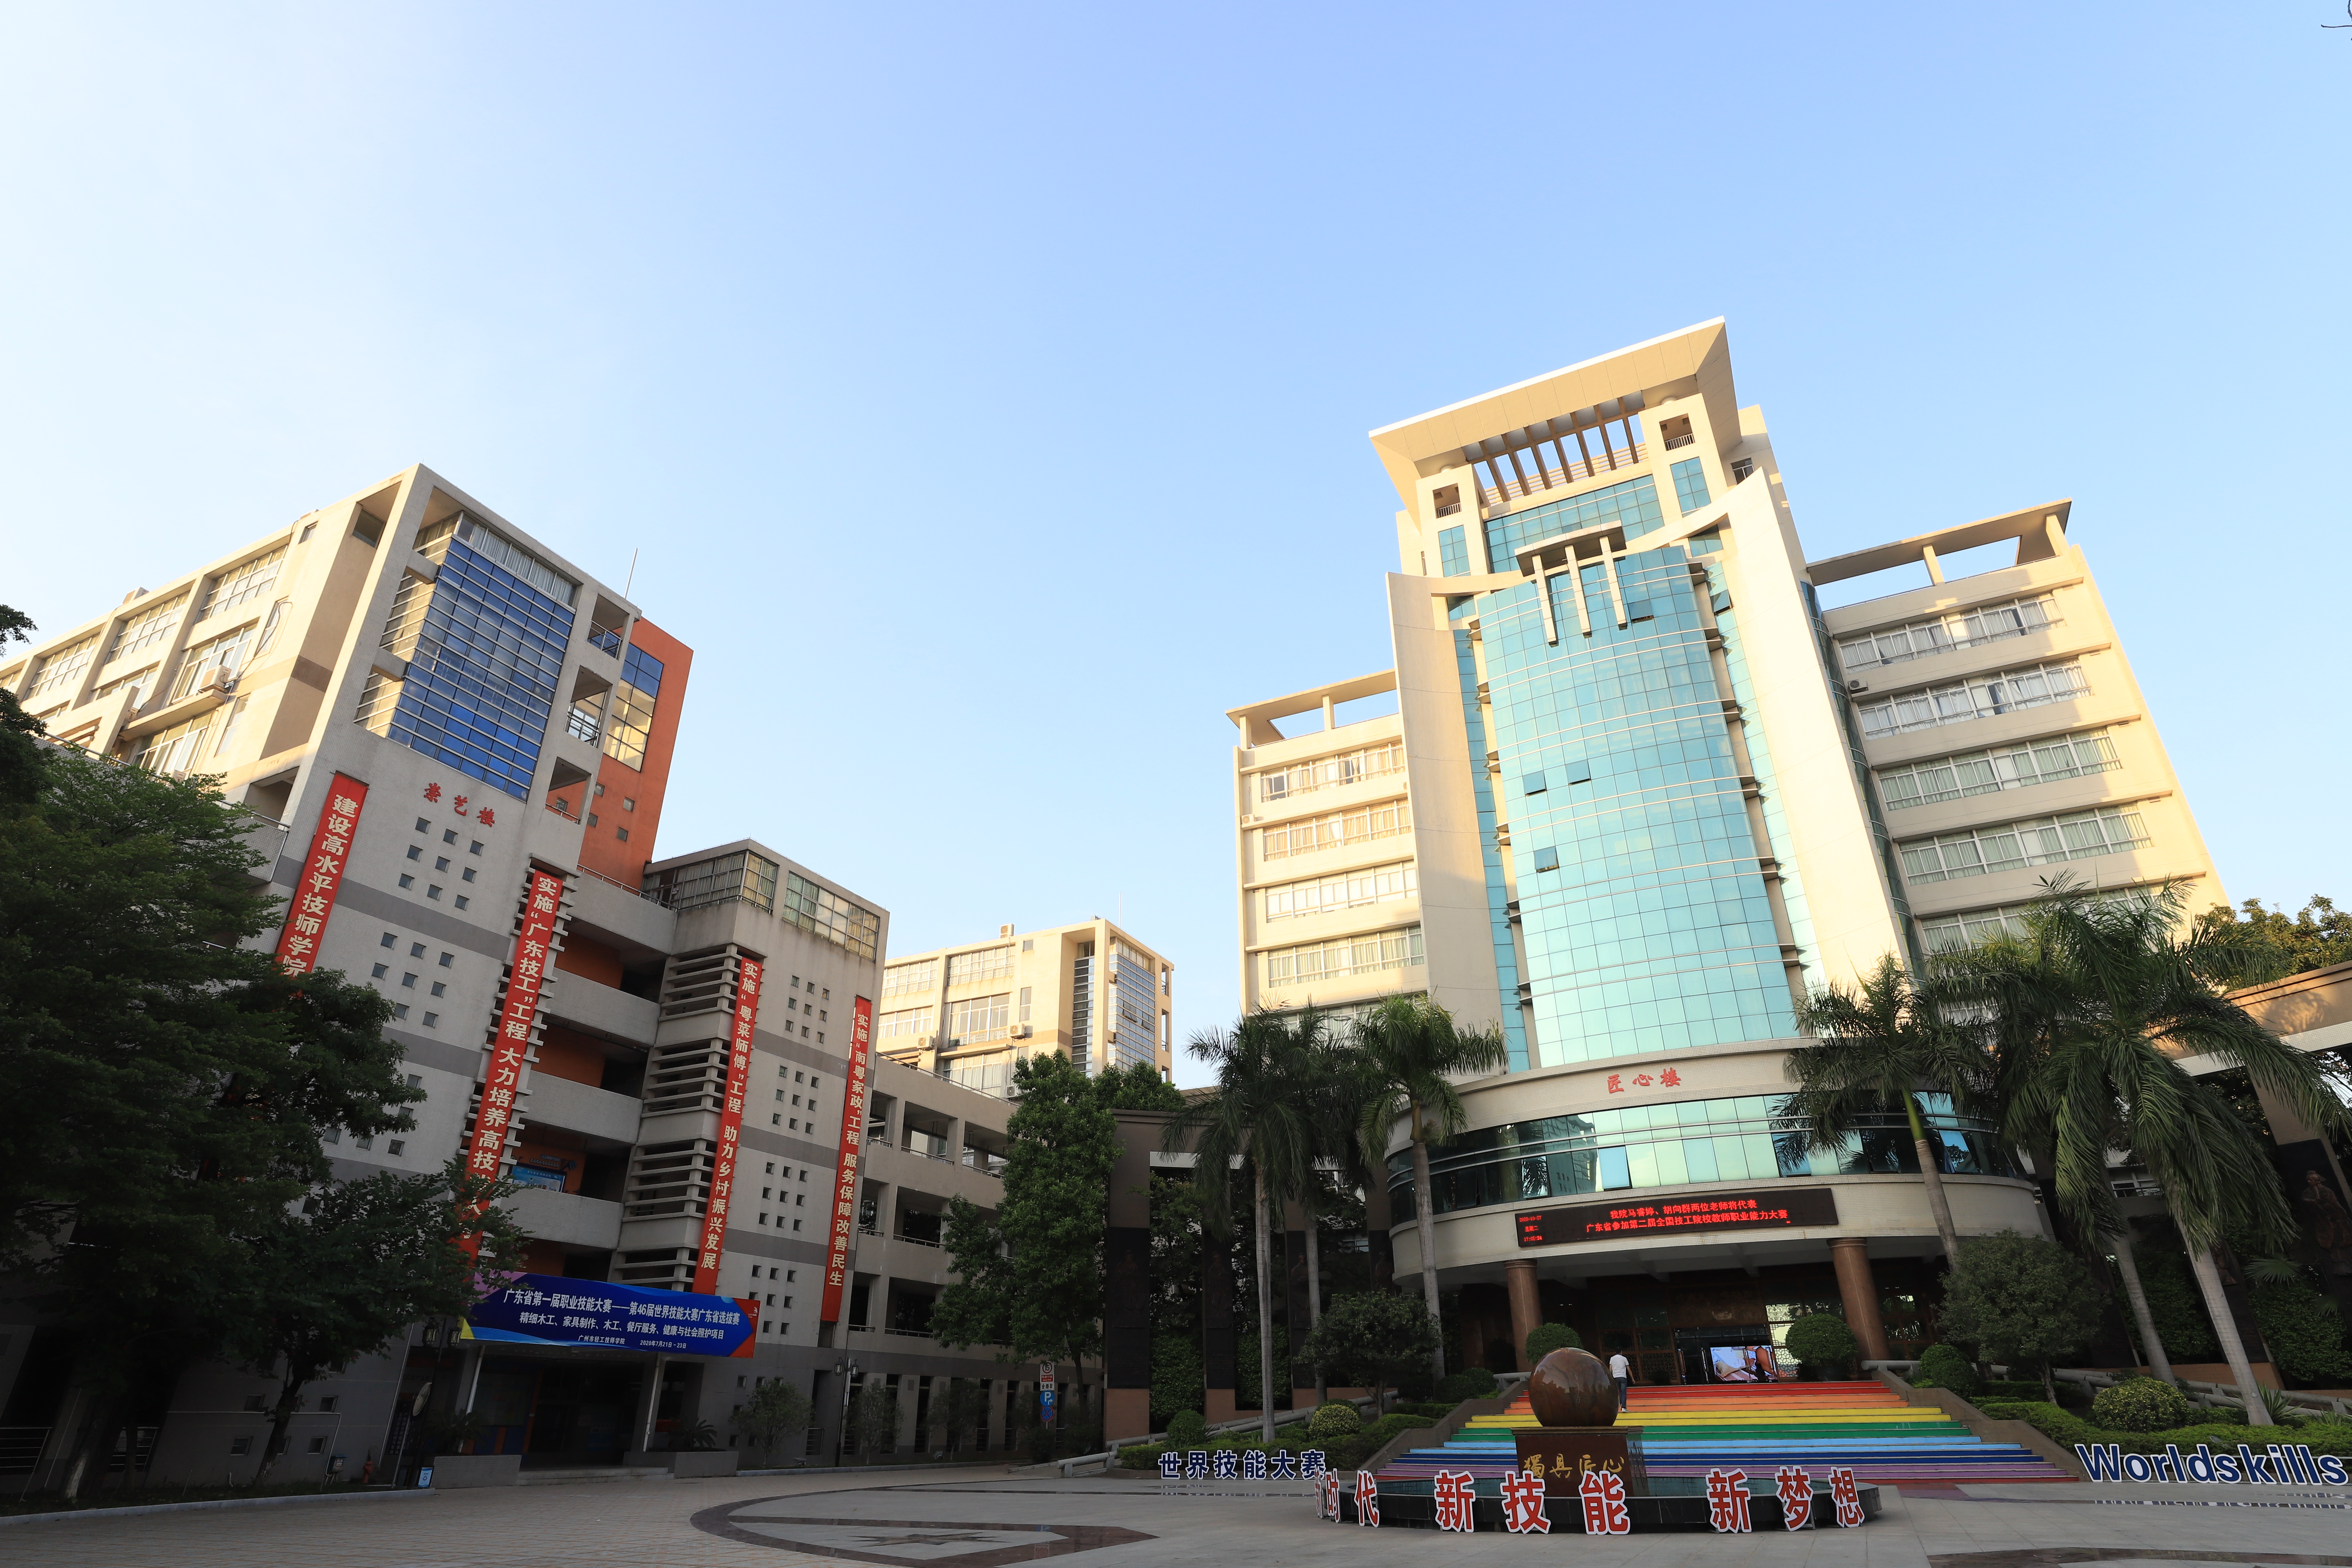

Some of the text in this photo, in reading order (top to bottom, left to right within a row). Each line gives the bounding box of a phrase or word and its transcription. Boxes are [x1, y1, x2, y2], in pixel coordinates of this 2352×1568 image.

[424, 782, 495, 827] 崇艺楼
[282, 794, 358, 978] 建设高水平技师学院
[1607, 1067, 1681, 1093] 匠心楼
[1586, 1209, 1788, 1232] 广东省参加第二届全国技工院校教师职业能力大赛
[578, 1335, 625, 1344] 广州市轻工技师学院
[1158, 1449, 1326, 1481] 世界技能大赛
[2074, 1444, 2349, 1485] Worldskills
[1434, 1469, 1631, 1535] 新技能
[1706, 1465, 1865, 1533] 新梦想
